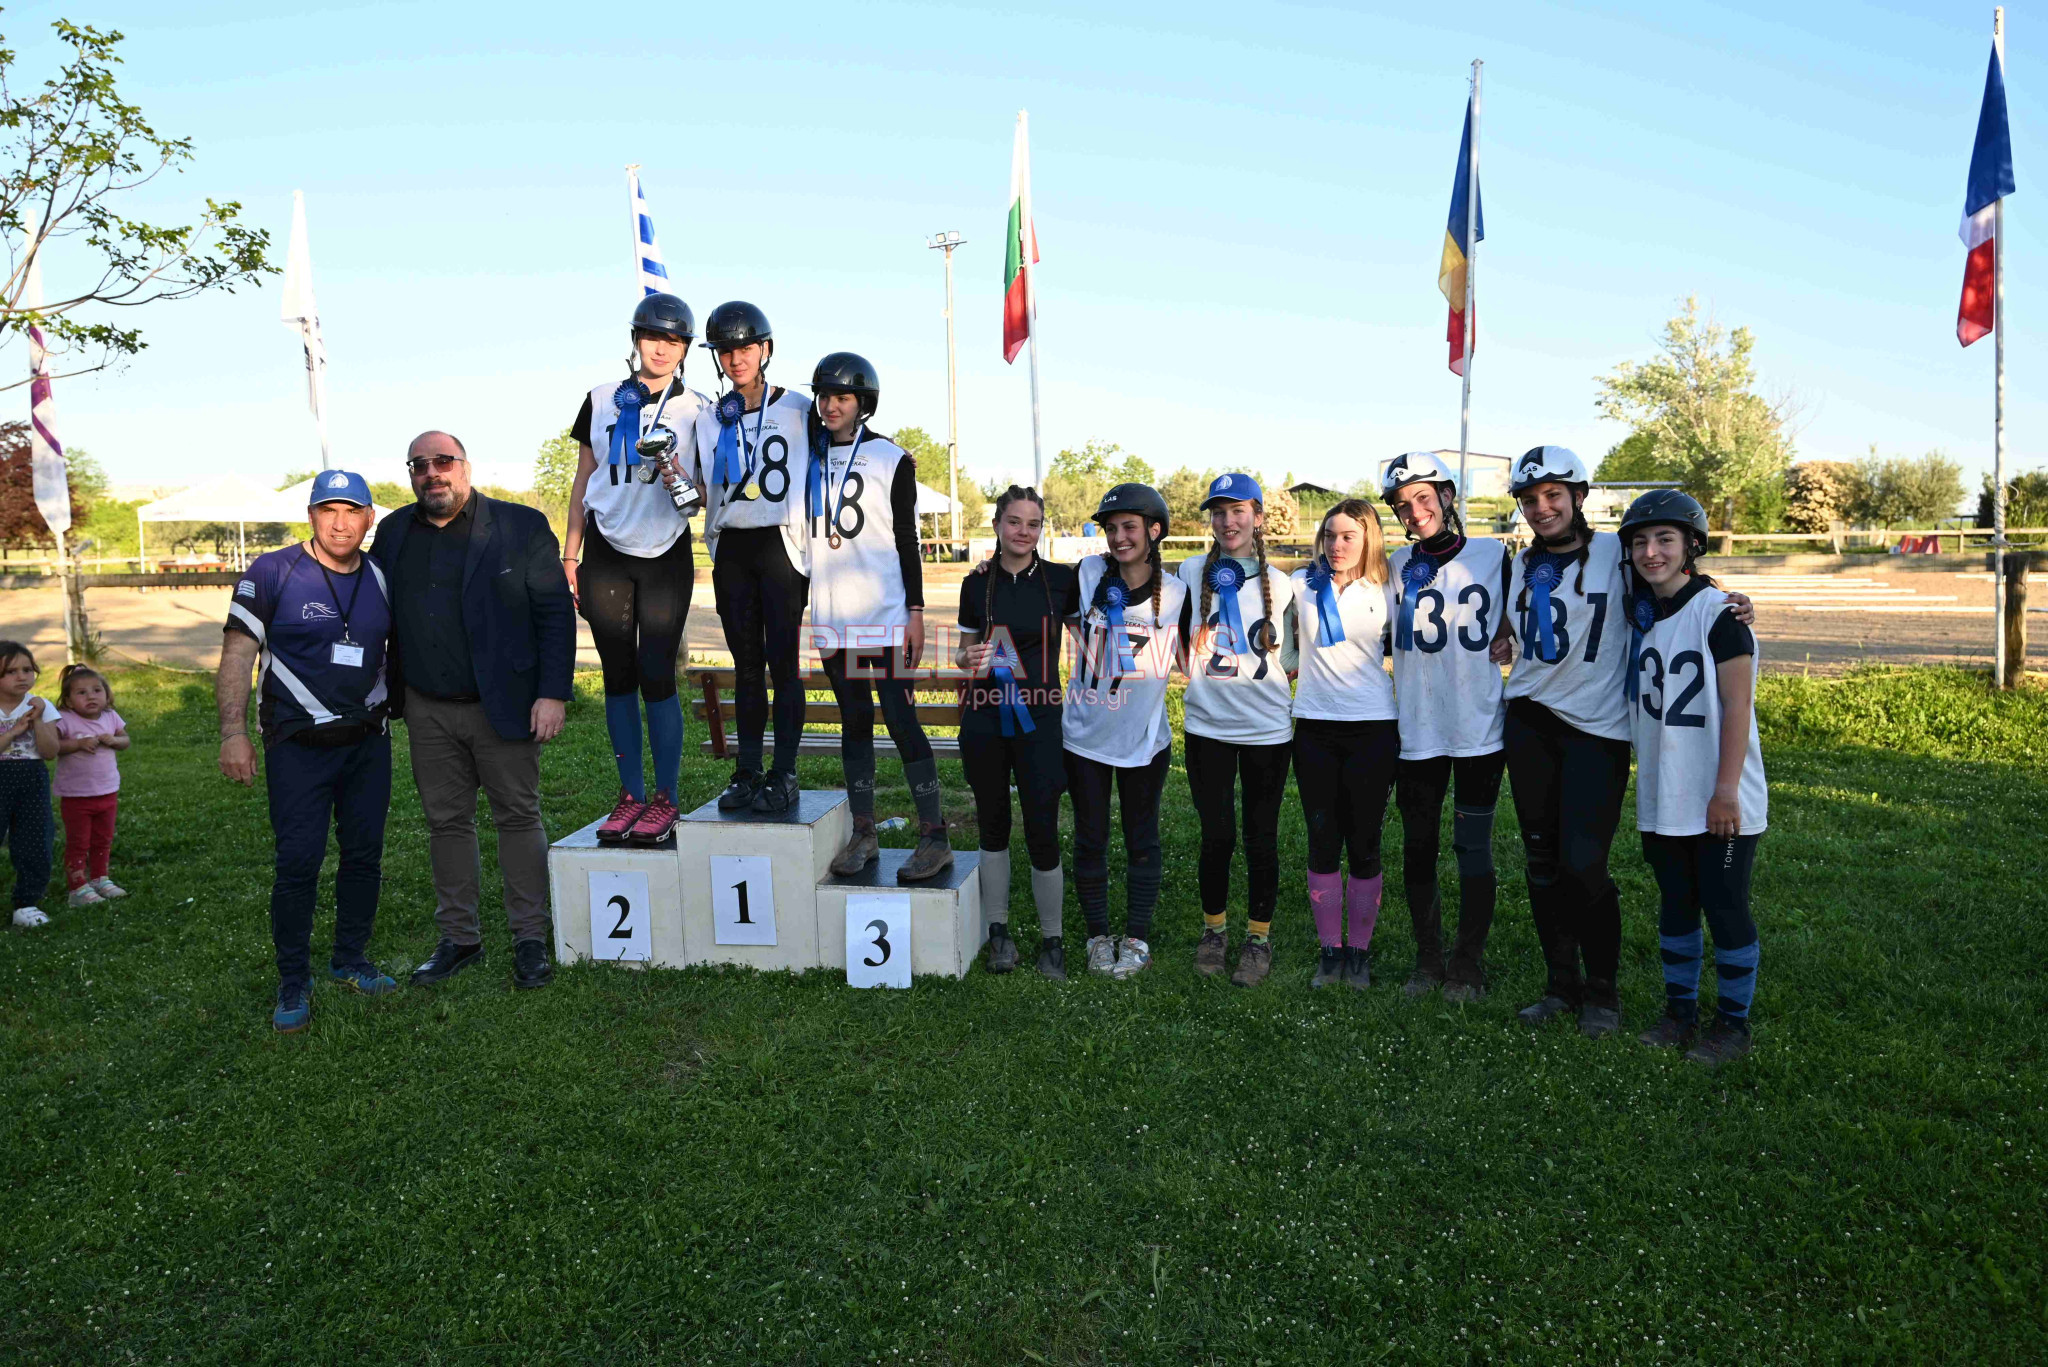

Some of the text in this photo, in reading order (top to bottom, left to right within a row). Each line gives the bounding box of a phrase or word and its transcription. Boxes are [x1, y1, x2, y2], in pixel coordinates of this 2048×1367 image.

[1521, 464, 1538, 475] LAS
[1104, 495, 1118, 503] LAS
[1723, 837, 1736, 869] TOMMY
[606, 894, 634, 939] 2
[730, 879, 757, 924] 1
[862, 918, 892, 967] 3
